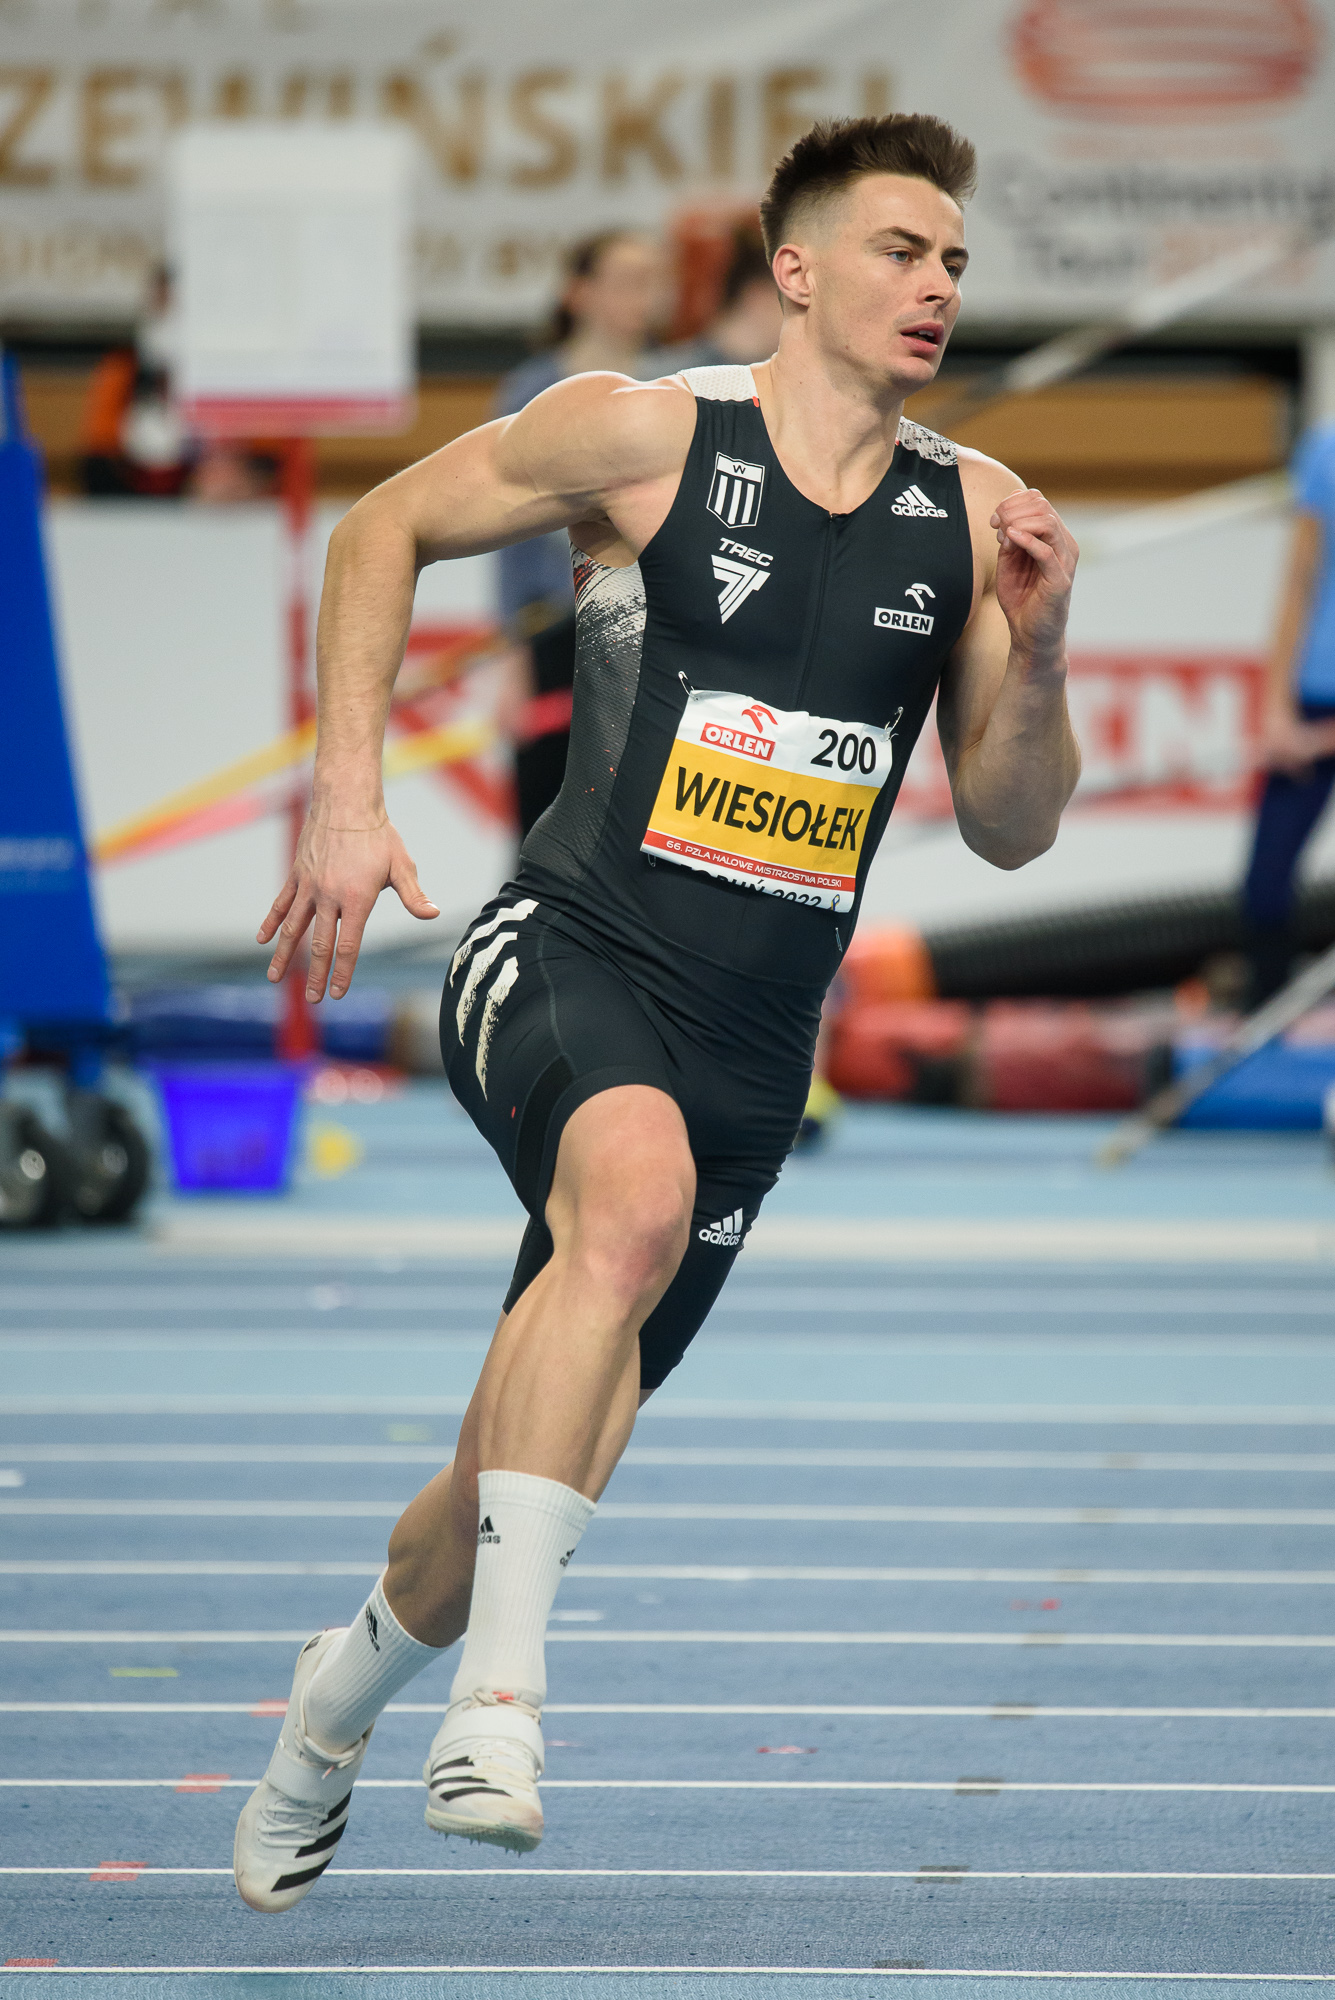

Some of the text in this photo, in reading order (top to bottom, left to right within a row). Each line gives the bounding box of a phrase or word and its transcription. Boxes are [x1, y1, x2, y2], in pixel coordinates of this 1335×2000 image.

[732, 464, 747, 475] W
[890, 502, 949, 518] adidas
[718, 537, 774, 567] TREC
[877, 611, 932, 632] ORLEN
[704, 726, 773, 759] ORLEN
[810, 728, 877, 775] 200
[674, 765, 865, 852] WIESIOŁEK
[666, 840, 684, 852] 66.
[685, 846, 711, 860] PZLA
[713, 854, 754, 871] HALOWE
[754, 866, 816, 885] MISTRZOSTWA
[817, 876, 843, 888] POLSKI
[698, 1228, 742, 1247] adidas
